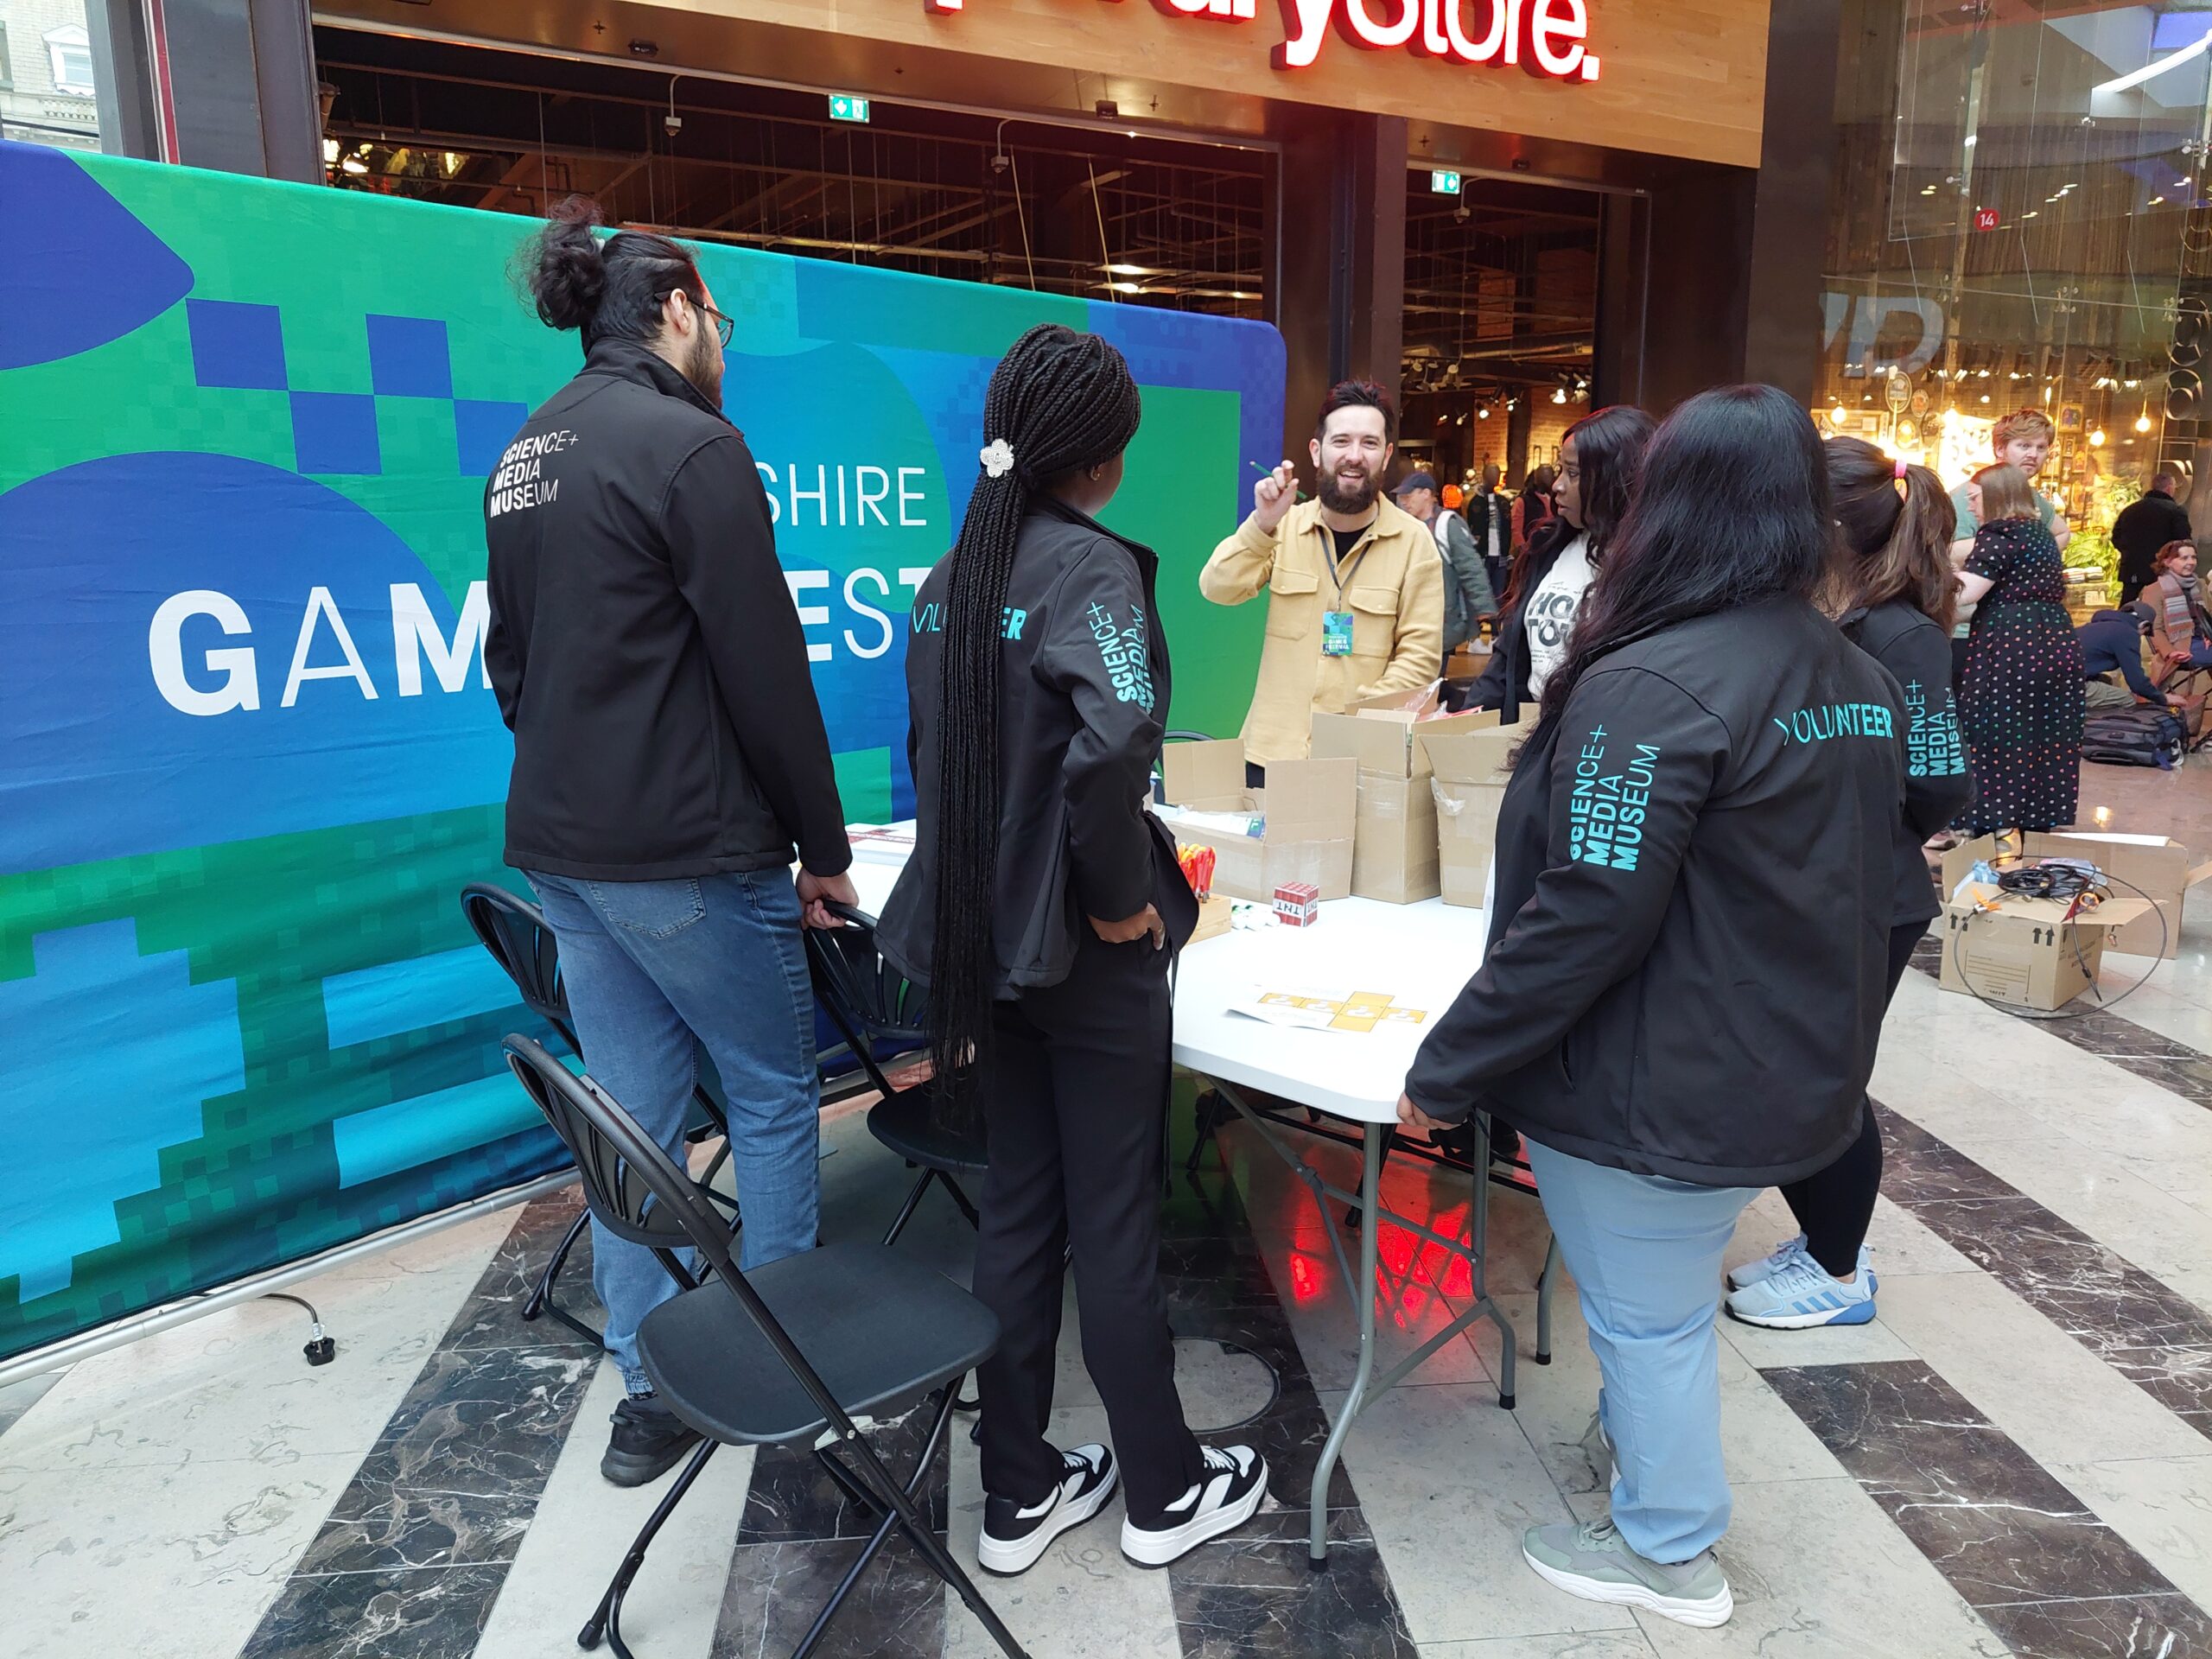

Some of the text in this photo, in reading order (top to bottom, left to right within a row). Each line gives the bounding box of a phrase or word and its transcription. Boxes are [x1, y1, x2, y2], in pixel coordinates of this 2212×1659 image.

[1980, 213, 1994, 227] 14
[493, 458, 540, 493] MEDIA
[490, 479, 559, 518] MUSEUM
[1774, 702, 1894, 747] VOLUNTEER
[1928, 711, 1948, 777] MEDIA
[1583, 774, 1624, 867] MEDIA
[1611, 743, 1662, 872] MUSEUM
[1276, 901, 1300, 915] TNT
